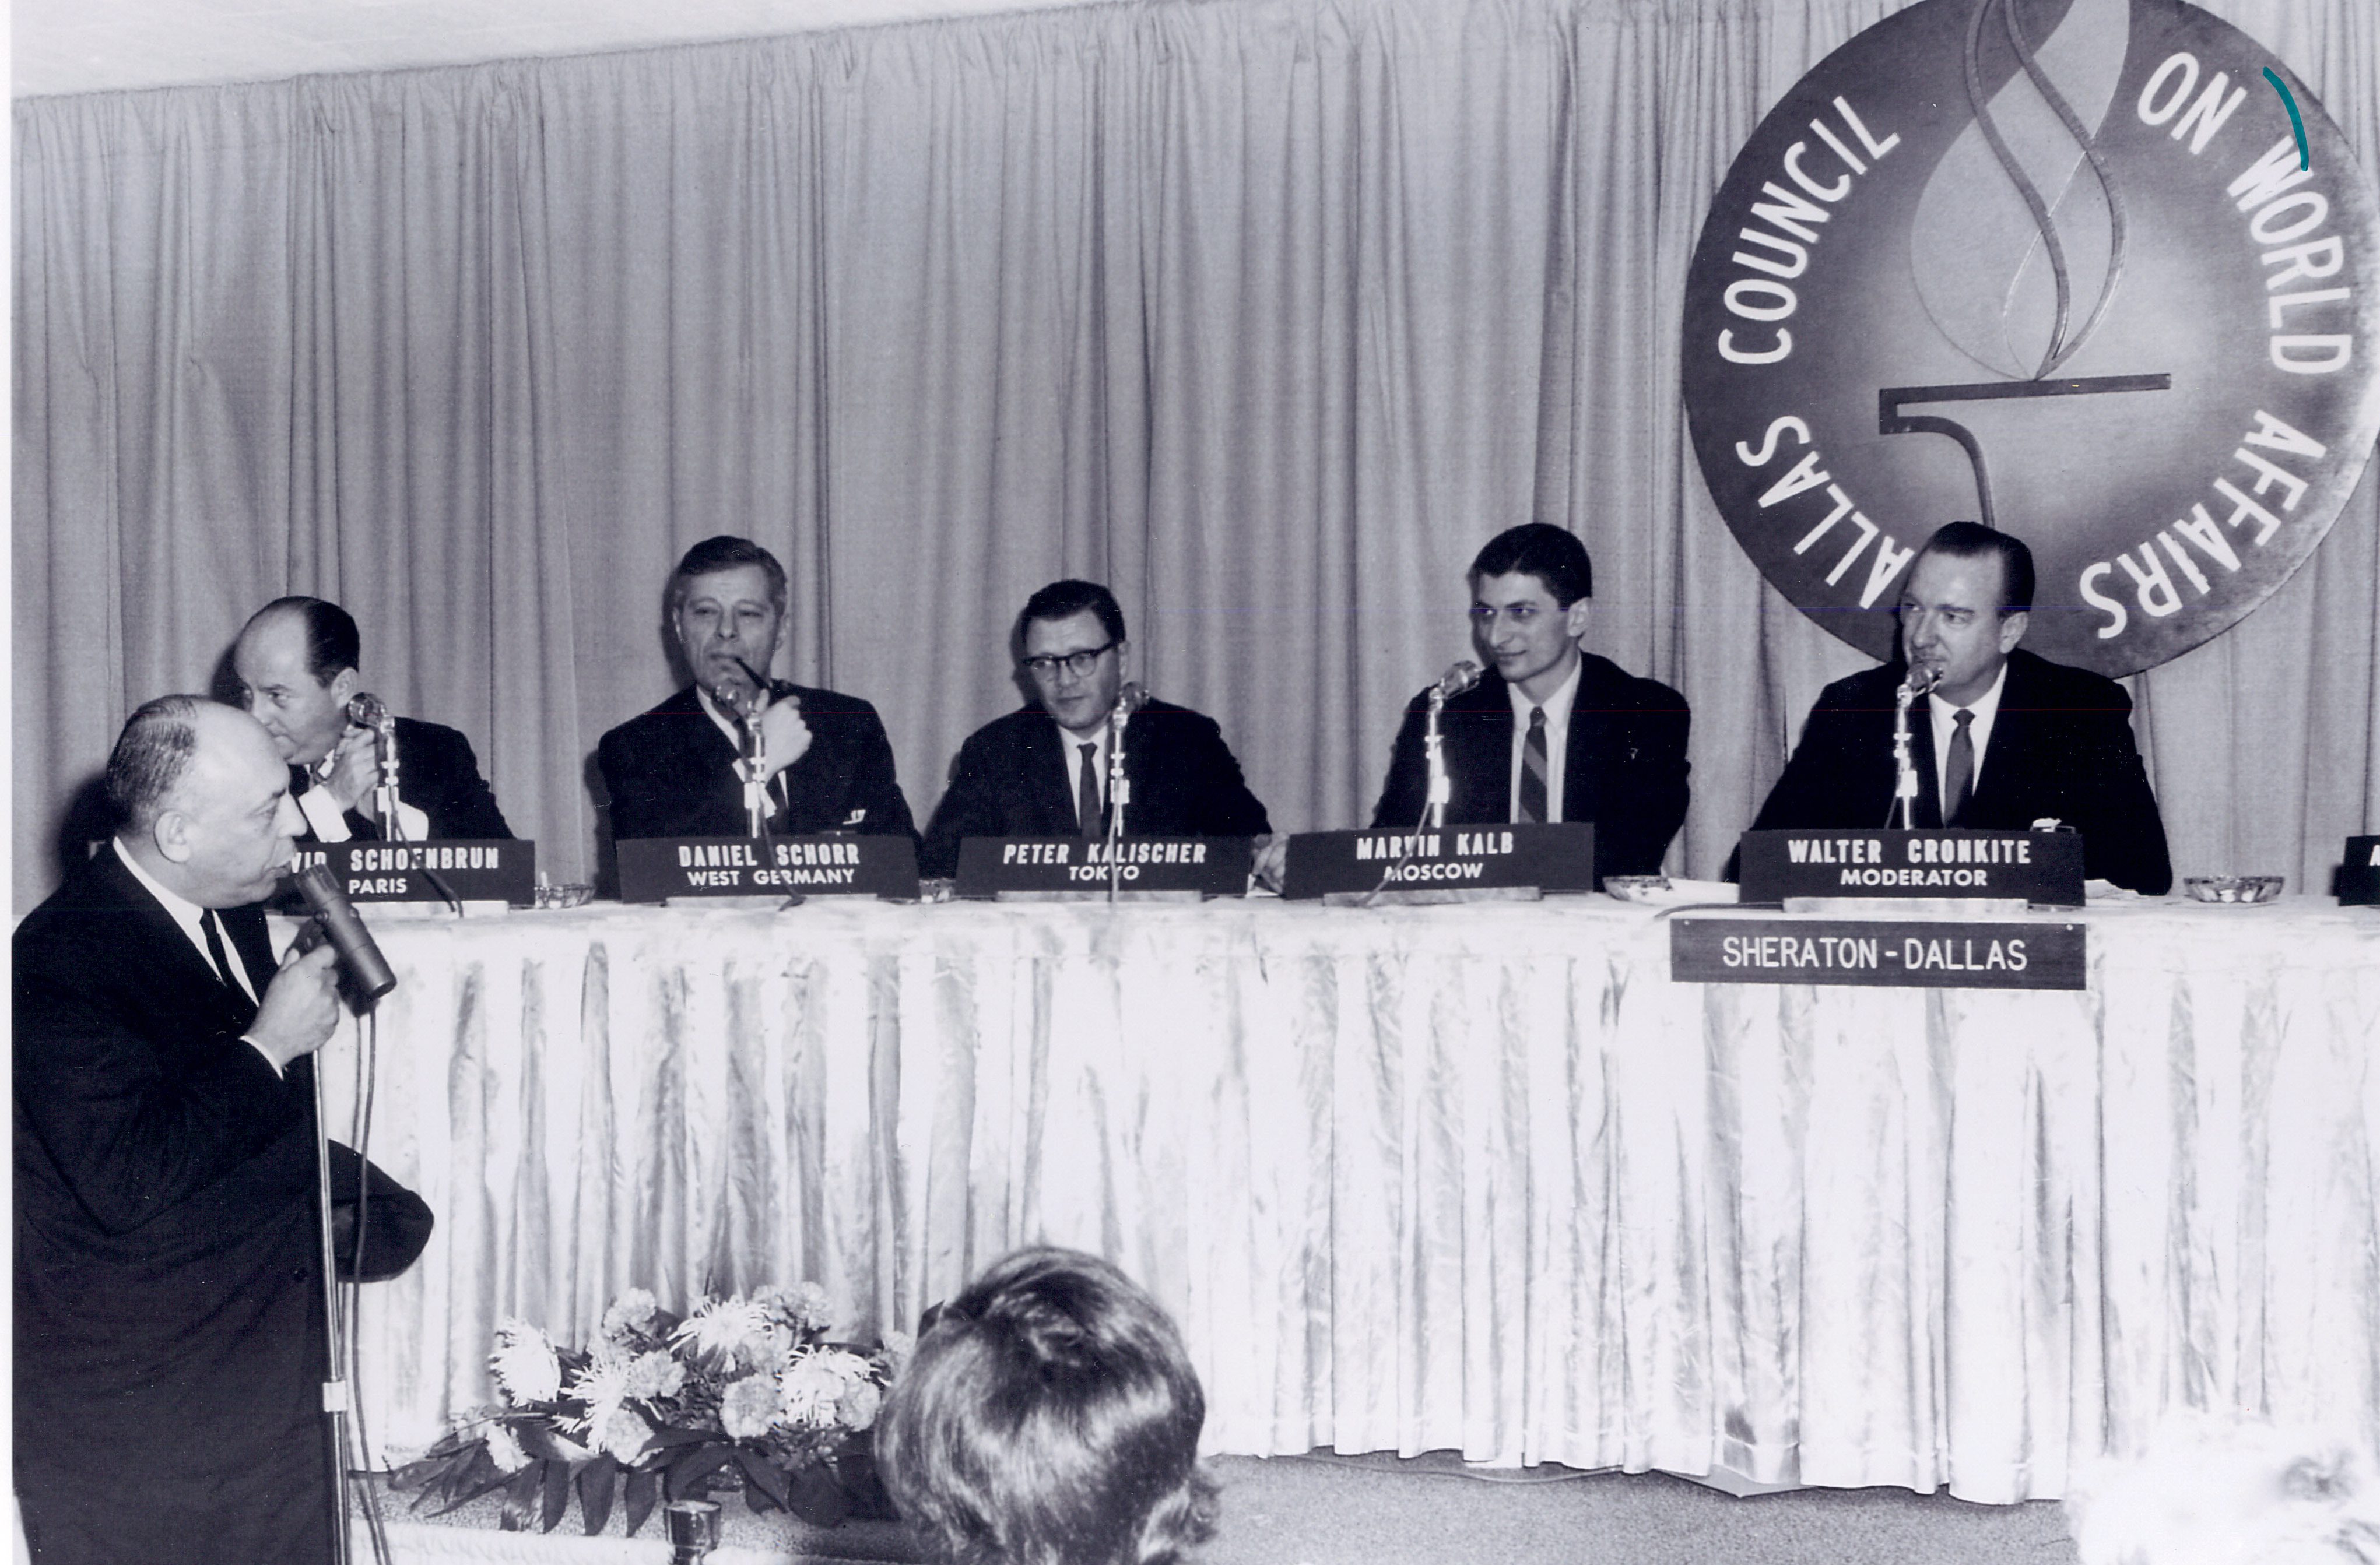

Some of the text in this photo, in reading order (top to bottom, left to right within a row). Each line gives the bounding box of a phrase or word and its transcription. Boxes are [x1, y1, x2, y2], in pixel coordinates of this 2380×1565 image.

[1718, 52, 2351, 639] ALLAS COUNCIL ON WORLD AFFAIRS
[678, 843, 861, 867] DANIEL SCHORR
[1003, 843, 1207, 864] PETER KALISCHER
[1357, 832, 1514, 860] MARVIN KALB
[1788, 839, 2031, 864] WALTER CRONKITE
[292, 847, 499, 874] VID SCHOENBRUN
[687, 868, 855, 886] WEST GERMANY
[1384, 862, 1484, 882] MOSCOW
[1840, 868, 1988, 887] MODERATOR
[349, 878, 408, 894] PARIS
